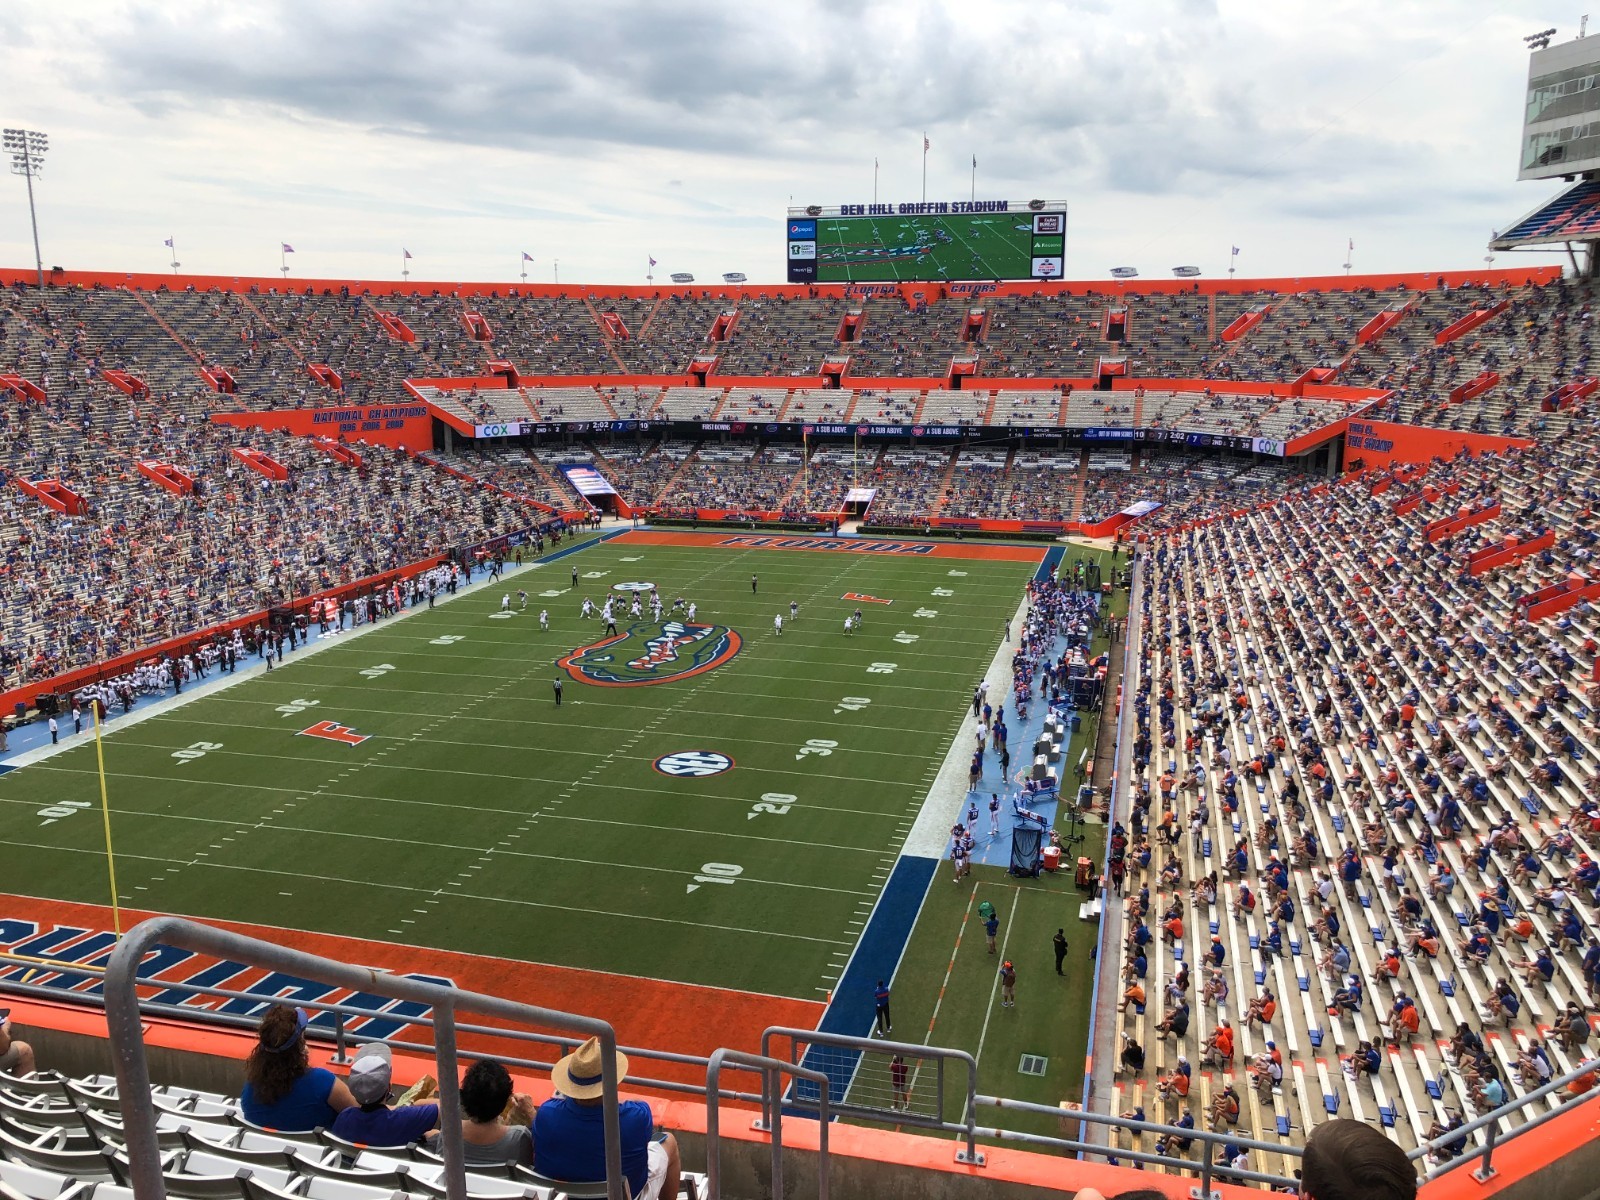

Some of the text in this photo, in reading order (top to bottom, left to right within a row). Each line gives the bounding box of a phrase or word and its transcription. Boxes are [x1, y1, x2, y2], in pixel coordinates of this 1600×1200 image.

[841, 200, 1008, 215] BEN HILL GRIFFIN STADIUM
[846, 284, 996, 294] FLORIDA GATORS
[313, 407, 427, 422] NATIONAL CHAMPIONS
[340, 423, 356, 432] 1996
[362, 421, 381, 431] 2006
[484, 425, 508, 436] COX
[1170, 431, 1185, 440] 2:02
[1259, 440, 1278, 454] COX
[718, 537, 938, 555] FLORIDA
[428, 634, 466, 645] 50
[892, 633, 920, 644] 40
[359, 663, 396, 675] 40
[866, 662, 898, 674] 50
[275, 698, 321, 713] 30
[837, 696, 871, 711] 40
[294, 720, 373, 747] F
[171, 741, 224, 759] 20
[799, 739, 839, 756] 30
[658, 751, 730, 776] SEC
[36, 800, 92, 818] 10
[752, 792, 798, 815] 20
[693, 862, 744, 885] 10
